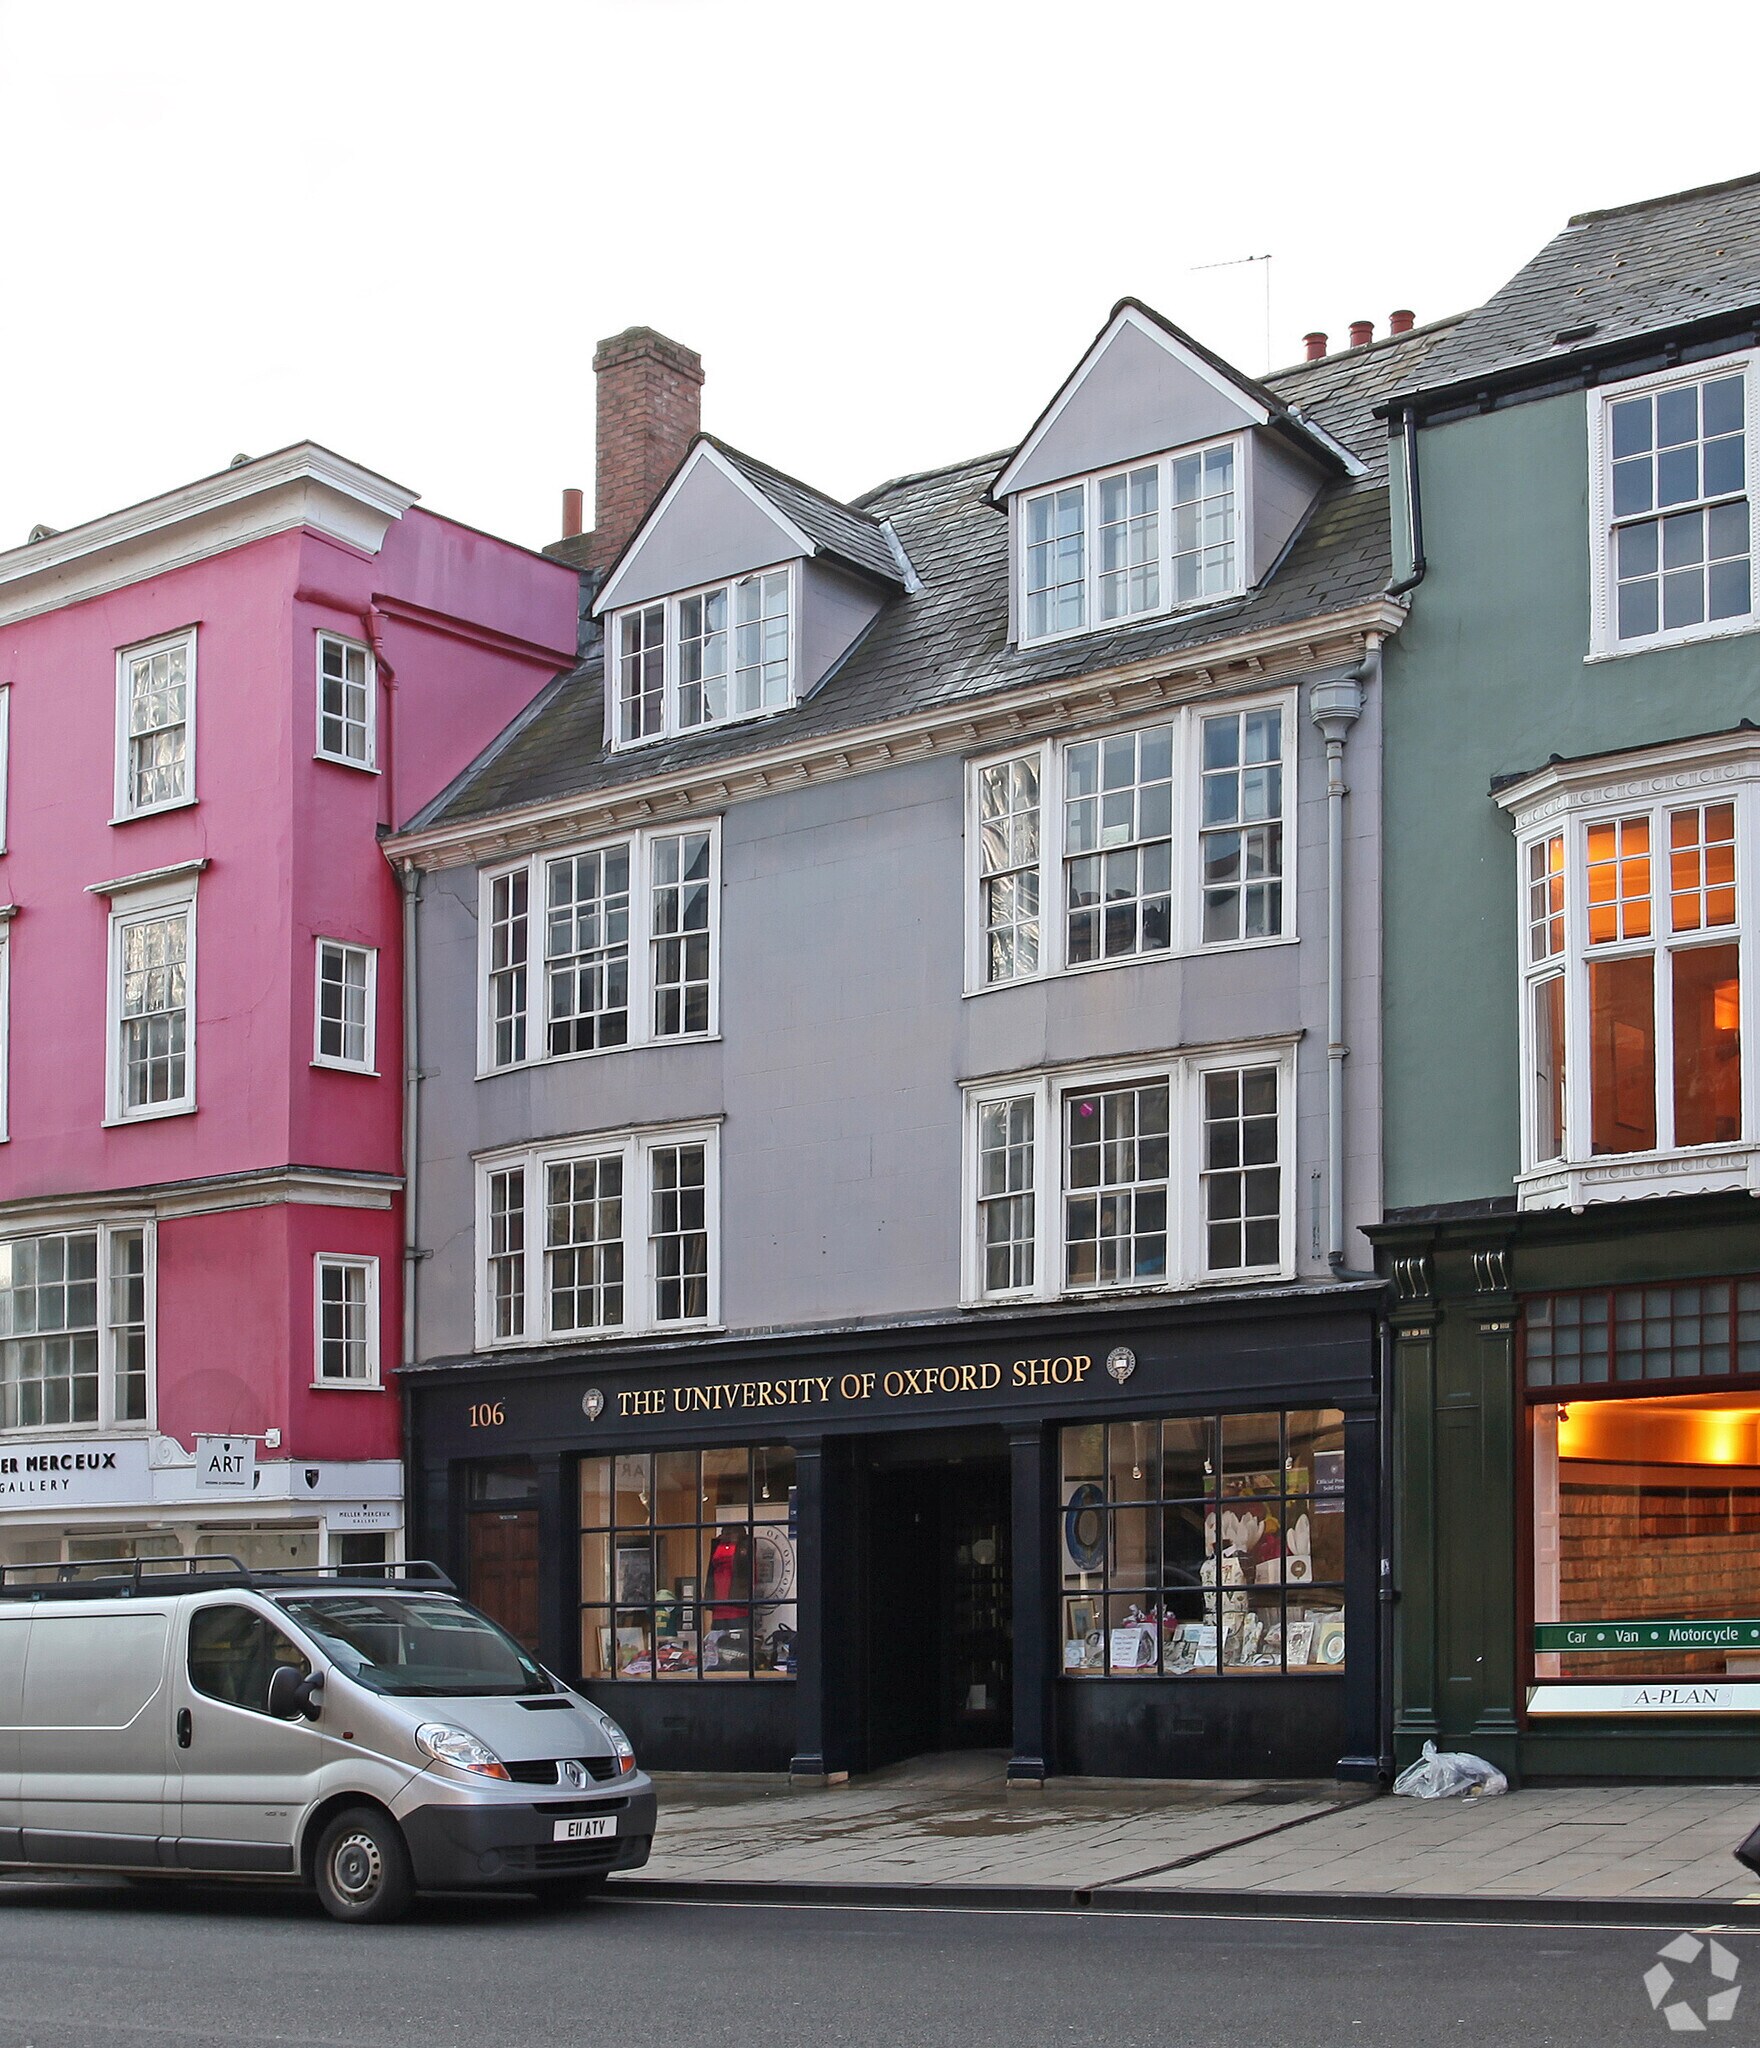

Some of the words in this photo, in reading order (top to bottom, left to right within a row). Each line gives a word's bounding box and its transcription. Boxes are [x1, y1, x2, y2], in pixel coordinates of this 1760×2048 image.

[618, 1389, 666, 1416] THE
[673, 1376, 834, 1412] UNIVERSITY
[840, 1372, 876, 1399] OF
[883, 1362, 1001, 1397] OXFORD
[1012, 1355, 1092, 1387] SHOP
[468, 1402, 505, 1427] 106
[26, 1453, 116, 1472] MERCEUX
[208, 1455, 244, 1472] ART
[0, 1479, 69, 1493] GALLERY
[1567, 1631, 1587, 1643] Car
[1615, 1630, 1639, 1643] Van
[1668, 1627, 1739, 1644] Motorcycle
[1634, 1688, 1719, 1704] A-PLAN
[568, 1822, 582, 1837] E11
[584, 1820, 606, 1836] ATV
